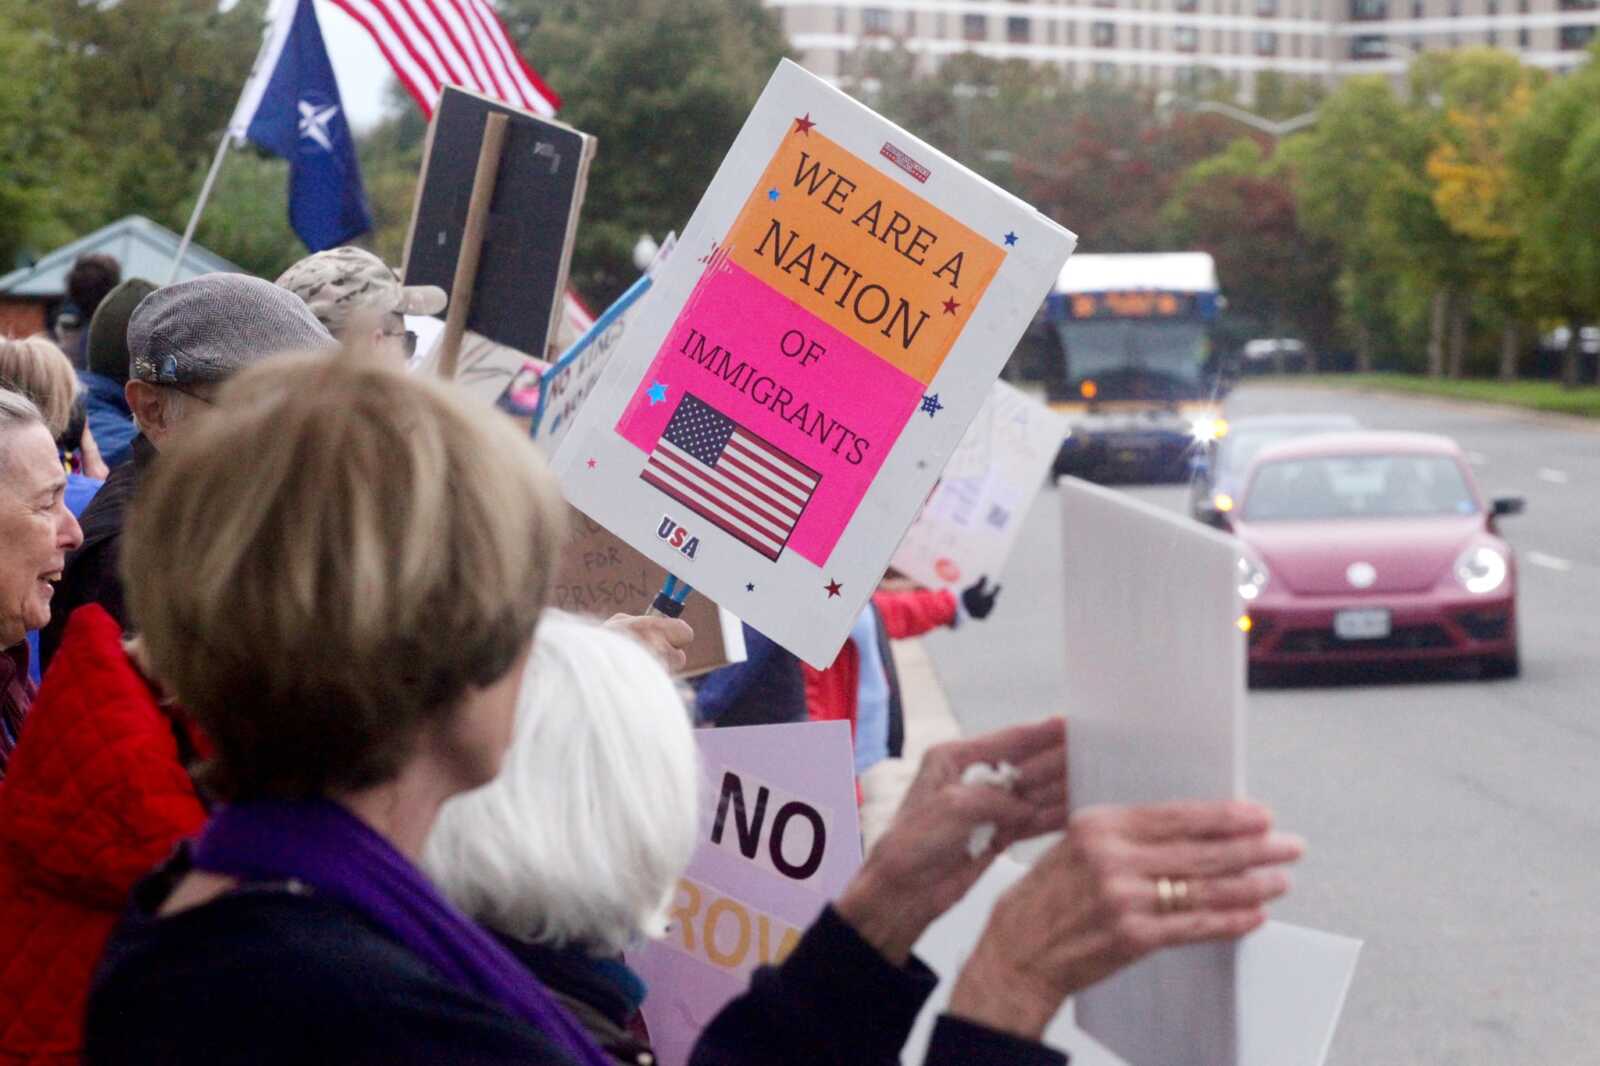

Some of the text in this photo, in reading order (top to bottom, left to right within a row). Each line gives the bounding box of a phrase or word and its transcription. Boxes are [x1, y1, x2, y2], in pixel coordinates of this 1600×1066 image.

[792, 151, 857, 215] WE
[851, 199, 938, 267] ARE
[932, 250, 967, 289] A
[754, 218, 931, 350] NATION
[679, 328, 871, 466] IMMIGRANTS
[779, 329, 827, 367] OF
[656, 515, 700, 560] USA
[710, 771, 827, 880] NO
